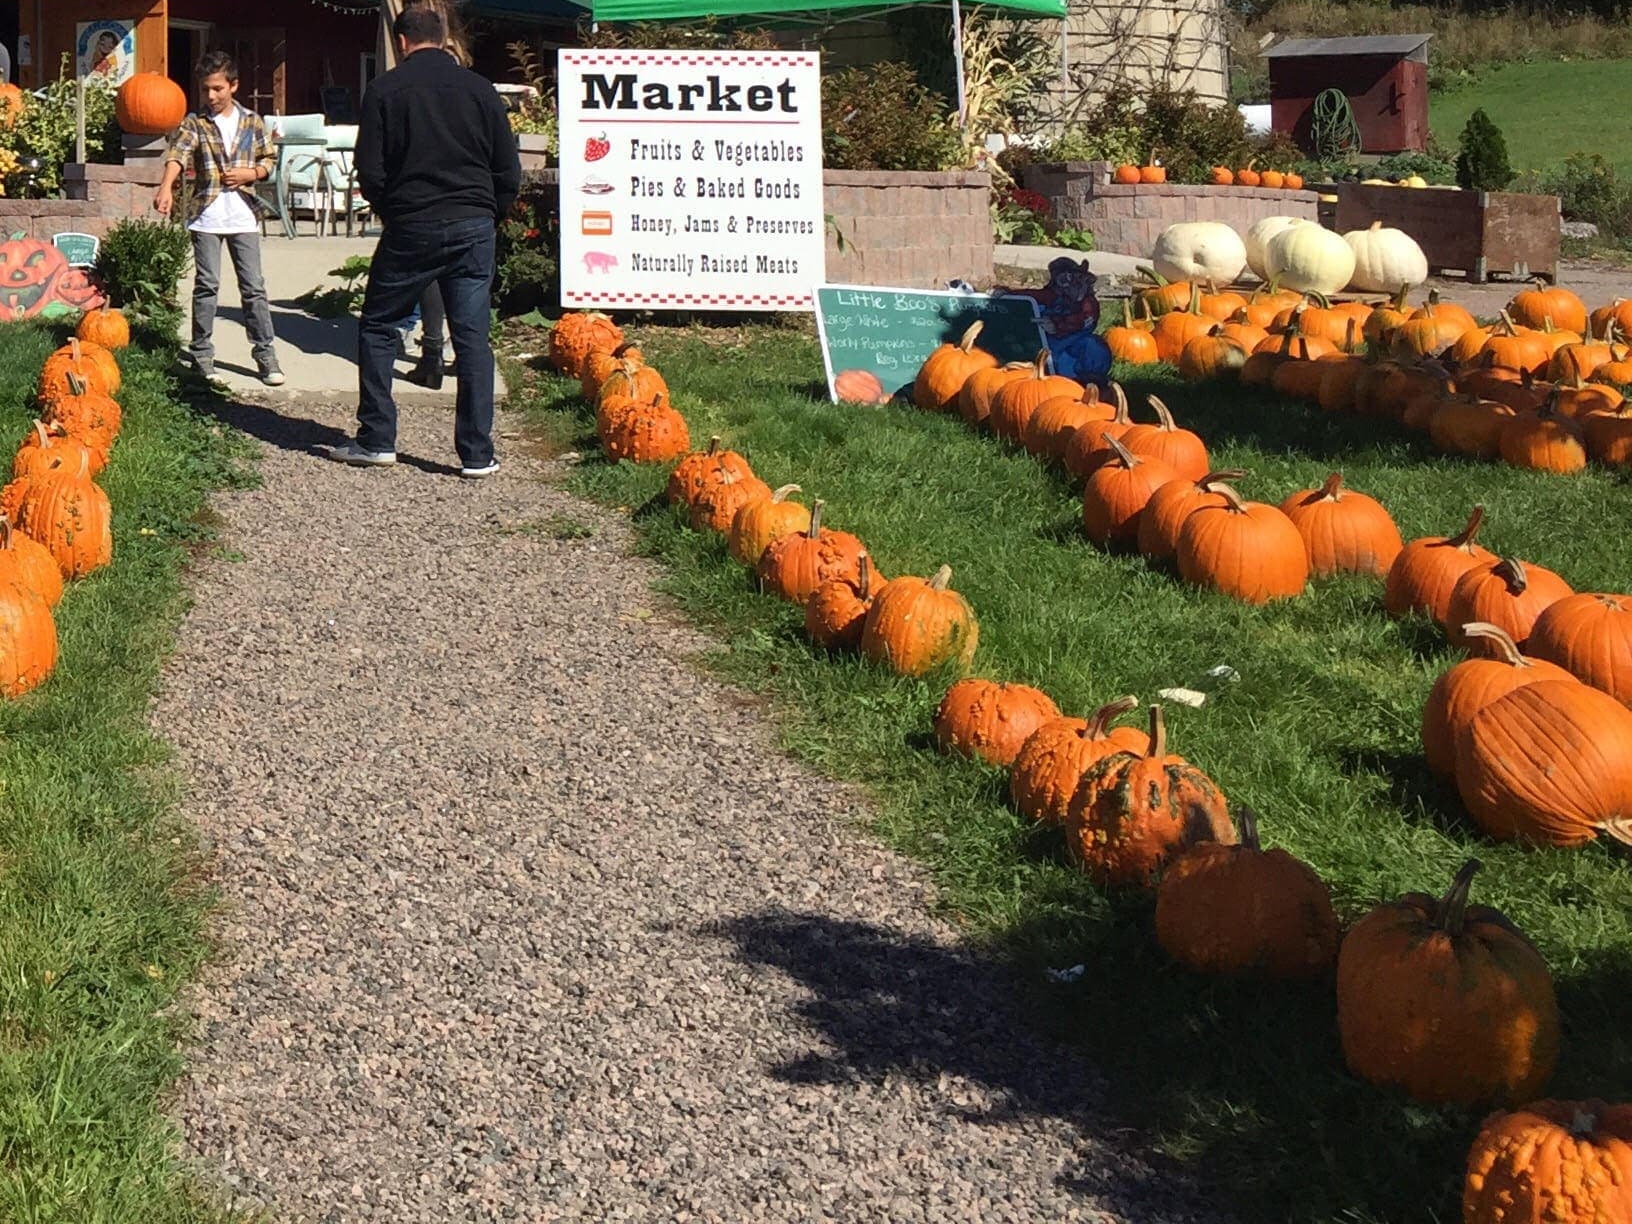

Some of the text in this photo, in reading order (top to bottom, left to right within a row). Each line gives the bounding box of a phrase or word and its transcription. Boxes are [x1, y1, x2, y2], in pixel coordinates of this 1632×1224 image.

[581, 73, 798, 113] Market
[630, 138, 804, 167] Fruits & Vegetables
[630, 176, 801, 200] Pies & Baked Goods
[631, 214, 814, 236] Honey, Jams & Preserves
[631, 253, 799, 276] Naturally Raised Meats
[836, 290, 886, 310] Little
[893, 293, 942, 313] Boo's
